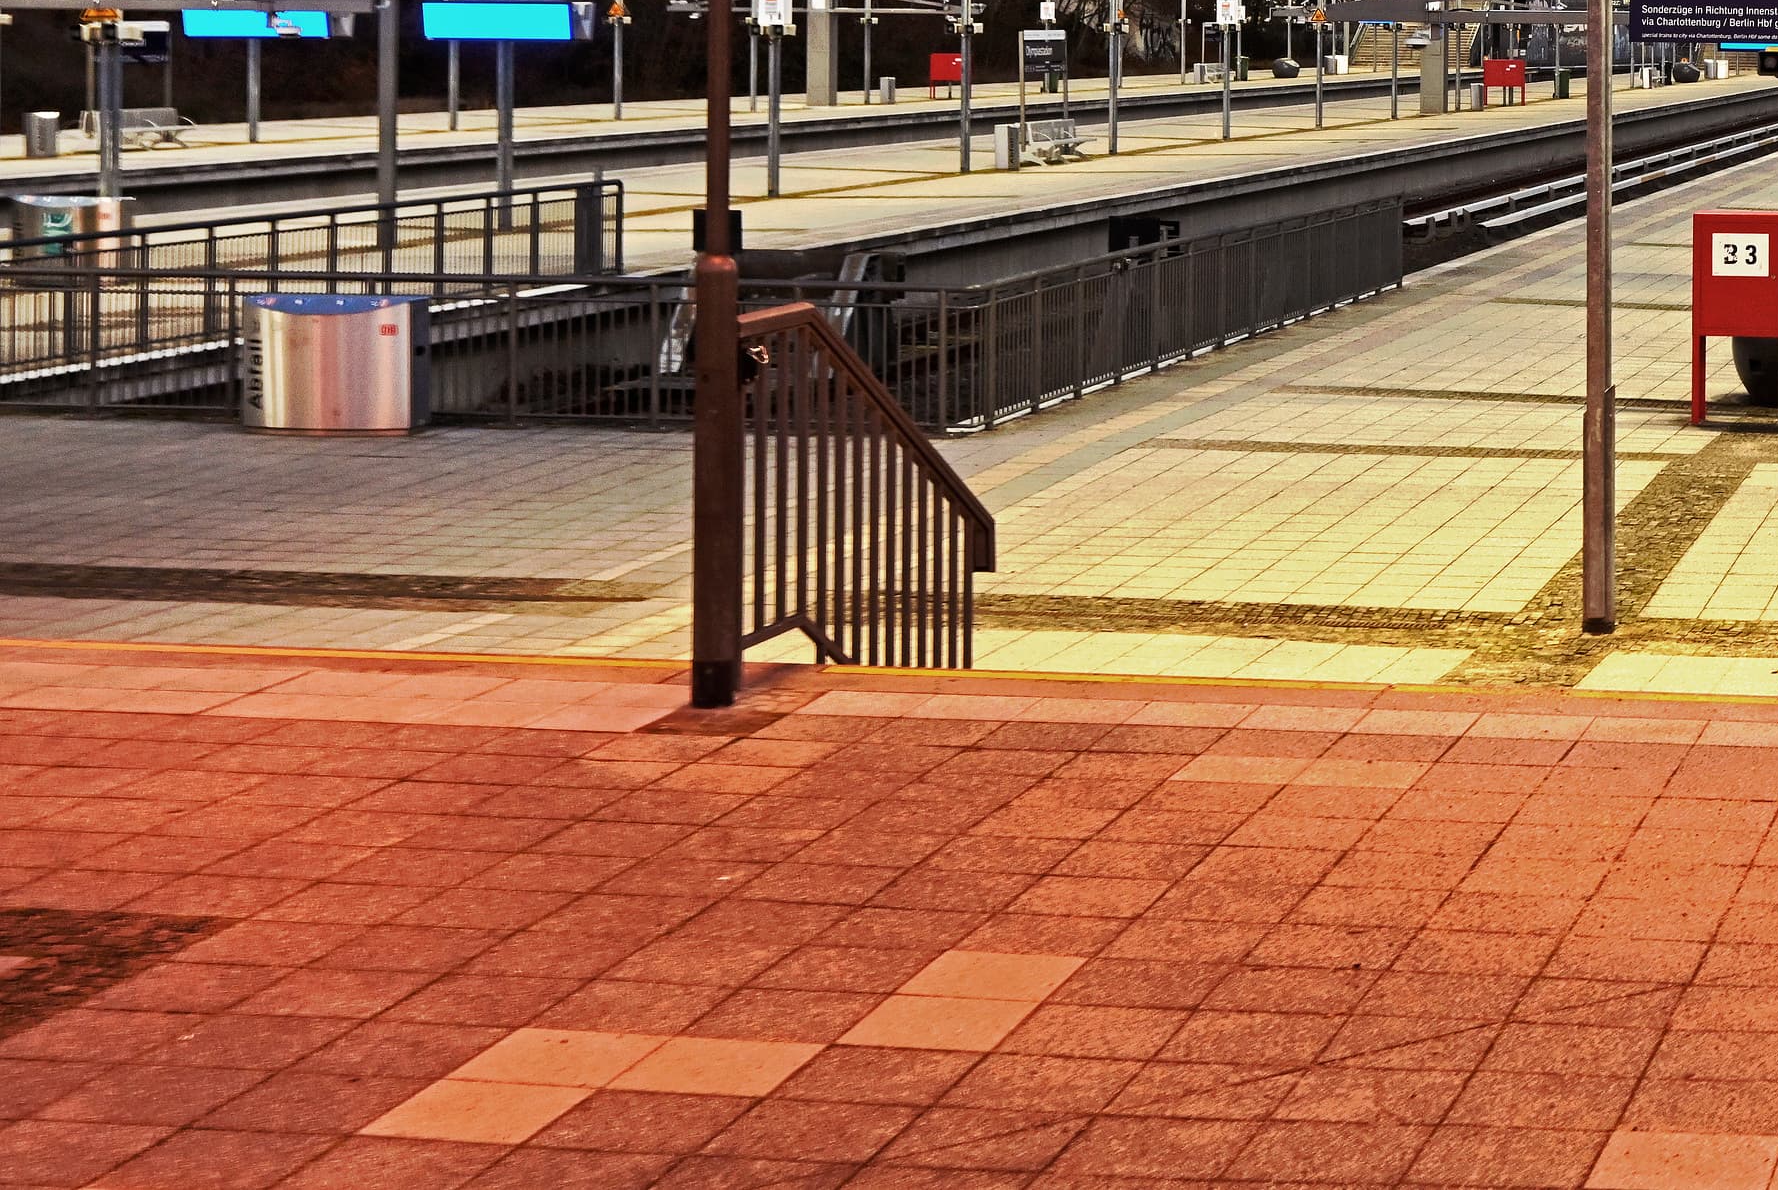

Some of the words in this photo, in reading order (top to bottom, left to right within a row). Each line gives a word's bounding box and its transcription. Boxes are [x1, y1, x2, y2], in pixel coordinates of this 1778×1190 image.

[1641, 4, 1693, 16] Sonderzüge
[1695, 5, 1703, 14] in
[1705, 5, 1744, 17] Richtung
[1641, 17, 1655, 26] via
[1656, 17, 1721, 29] Charlottenburg
[1729, 18, 1755, 27] Berlin
[1757, 18, 1773, 28] Hbf
[246, 338, 264, 410] Abfall
